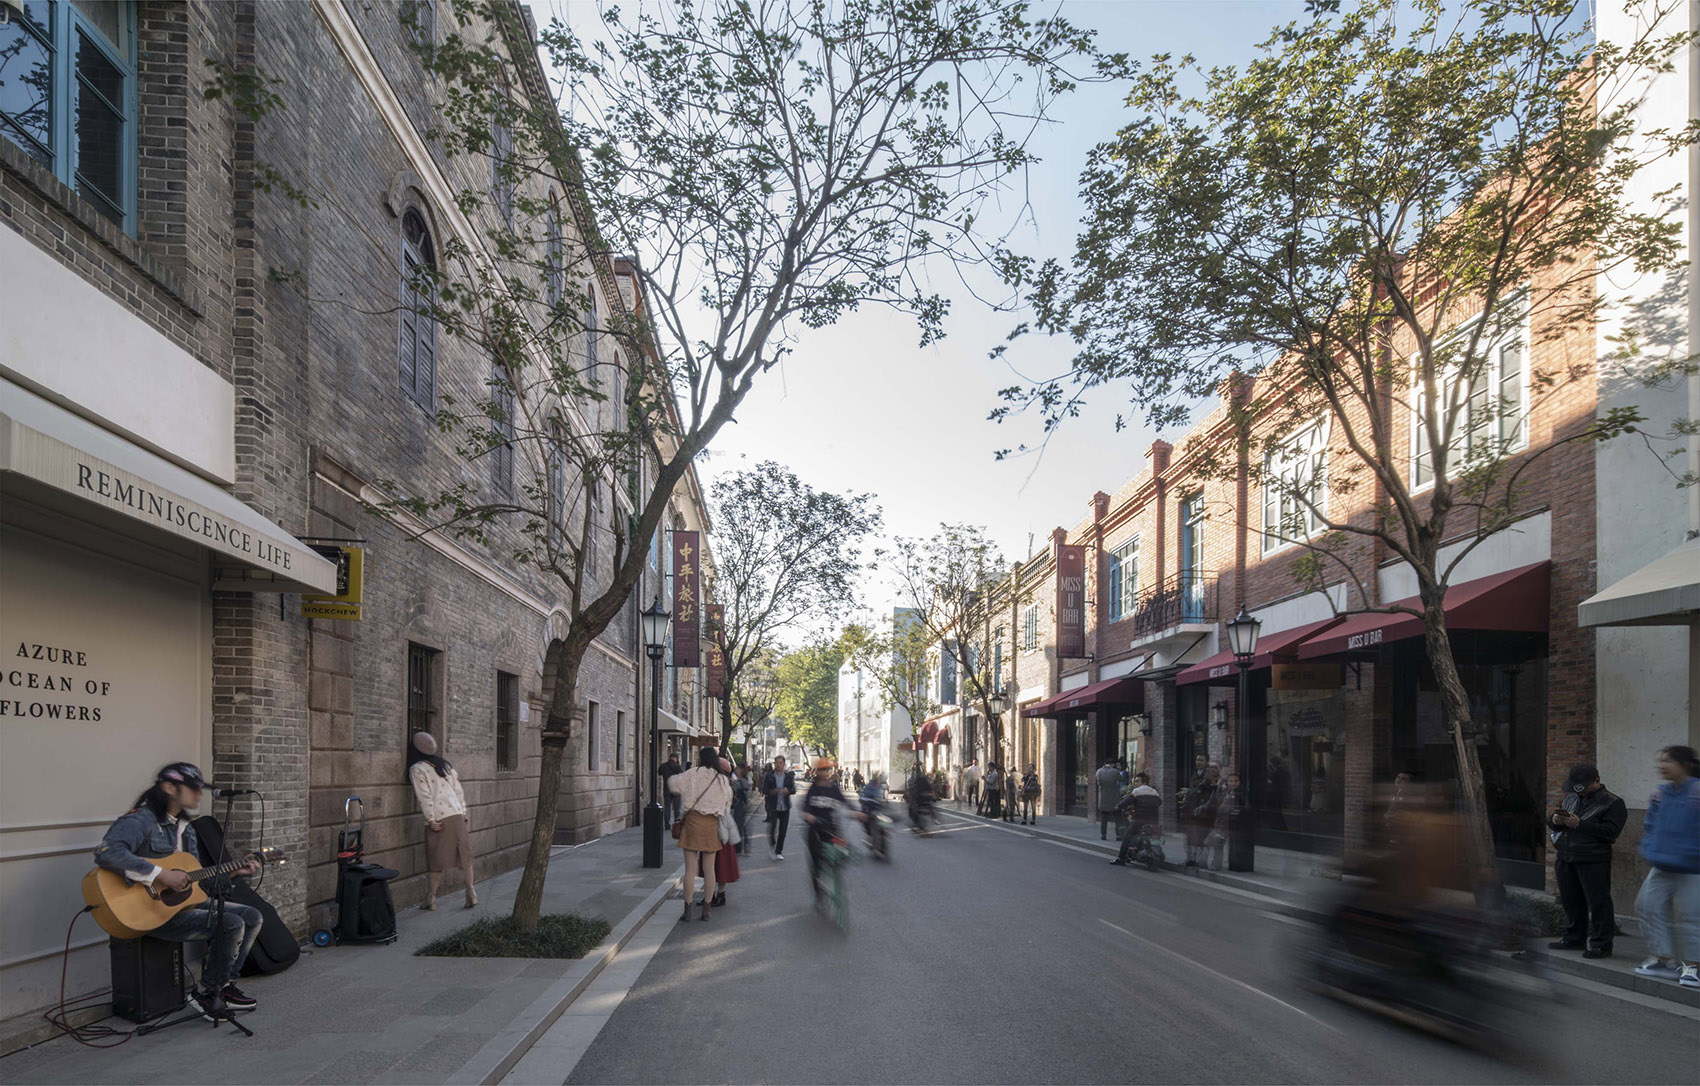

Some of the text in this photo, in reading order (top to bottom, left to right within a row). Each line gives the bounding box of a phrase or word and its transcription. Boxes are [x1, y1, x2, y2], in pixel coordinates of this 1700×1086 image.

[77, 463, 292, 570] REMINISCENCE LIFE
[1061, 577, 1081, 592] MISS
[1068, 593, 1074, 608] U
[303, 606, 358, 616] HOCKCHEW
[1062, 609, 1079, 624] BAR
[1348, 634, 1363, 649] MISS
[1370, 629, 1383, 644] BAR
[16, 641, 87, 667] AZURE
[0, 670, 111, 696] CEAN OF
[0, 700, 102, 722] FLOWERS
